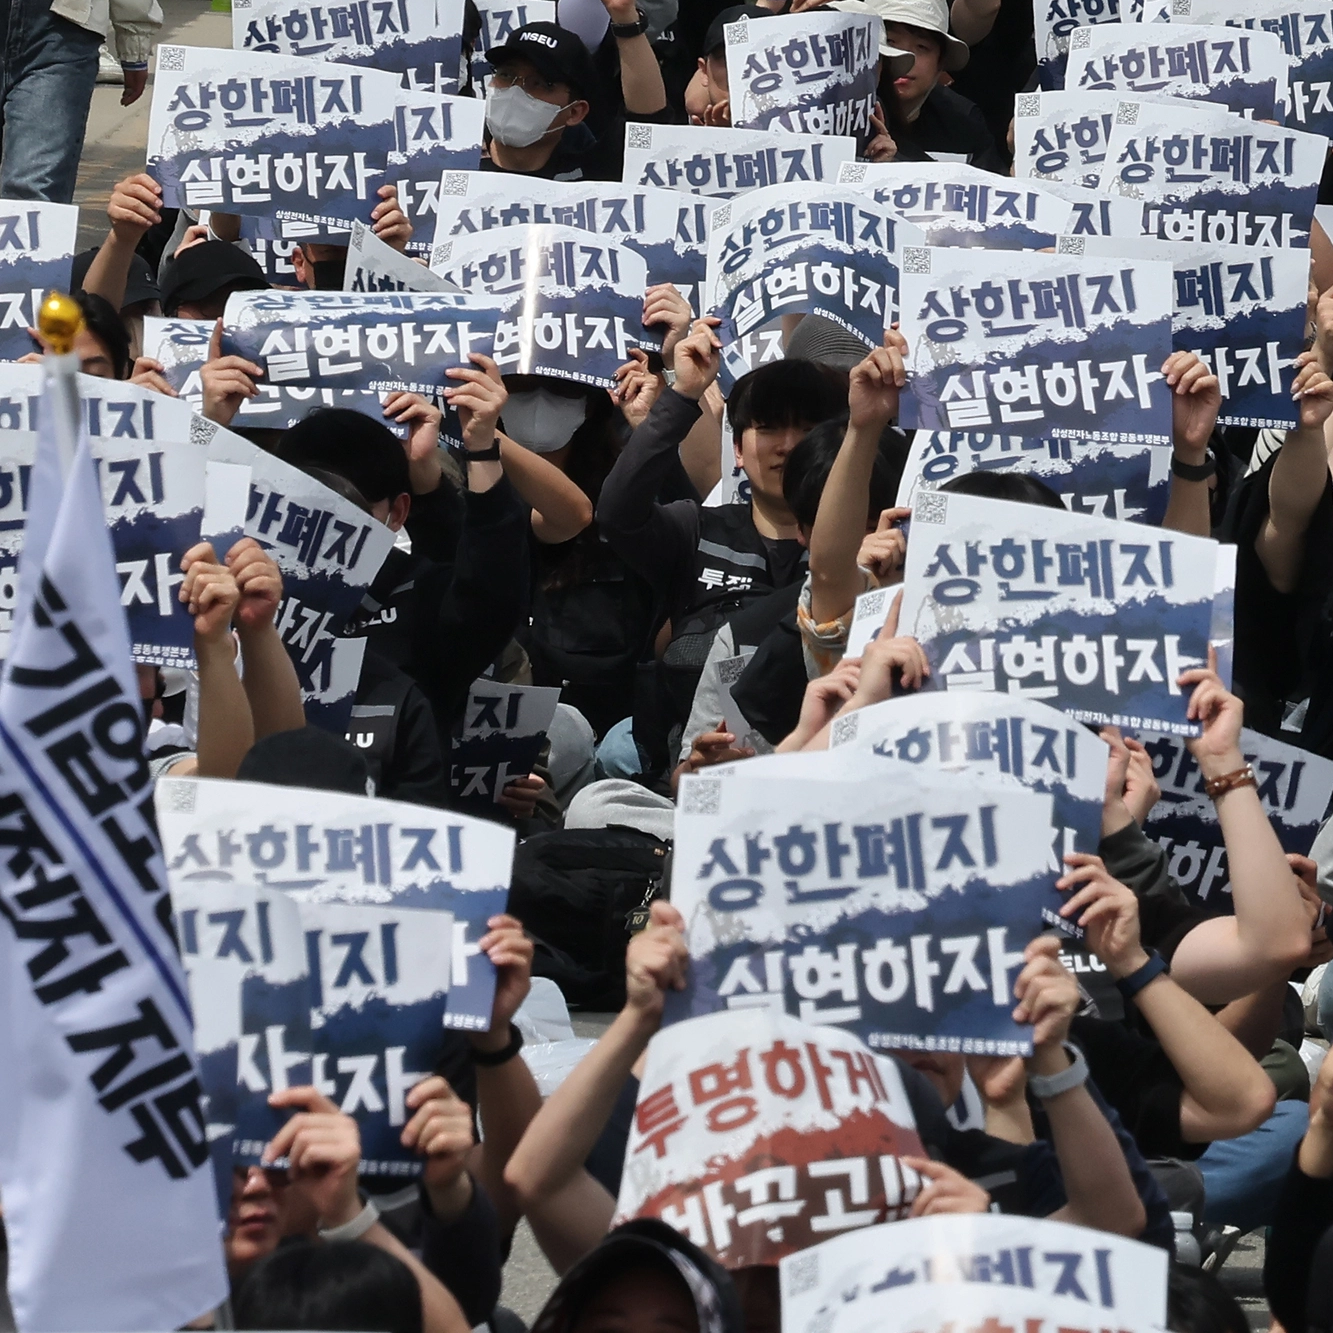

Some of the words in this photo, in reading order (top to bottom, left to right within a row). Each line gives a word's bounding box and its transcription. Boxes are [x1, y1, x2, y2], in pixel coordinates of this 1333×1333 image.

[520, 31, 558, 49] NSEU
[741, 22, 874, 95] 상한폐지
[167, 75, 363, 131] 상한폐지
[179, 151, 385, 207] 실현하자
[1115, 131, 1297, 183] 상한폐지
[719, 200, 898, 271] 상한폐지
[730, 261, 900, 338] 실현하자
[918, 268, 1137, 343] 상한폐지
[260, 322, 498, 385] 실현하자
[495, 315, 639, 363] 현하자
[940, 358, 1167, 430] 실현하자
[1050, 428, 1118, 442] 삼성전자노동조합
[1120, 431, 1170, 446] 공동투쟁본부
[697, 567, 753, 593] 투쟁
[922, 538, 1175, 607] 상한폐지
[938, 634, 1210, 701] 실현하자
[166, 821, 465, 886] 상한폐지
[696, 804, 1000, 912] 상한폐지
[718, 926, 1030, 1026] 실현하자
[867, 1032, 960, 1051] 삼성전자노동조합
[962, 1037, 1031, 1056] 공동투쟁본부
[65, 996, 209, 1182] 지부
[630, 1035, 891, 1159] 투명하게
